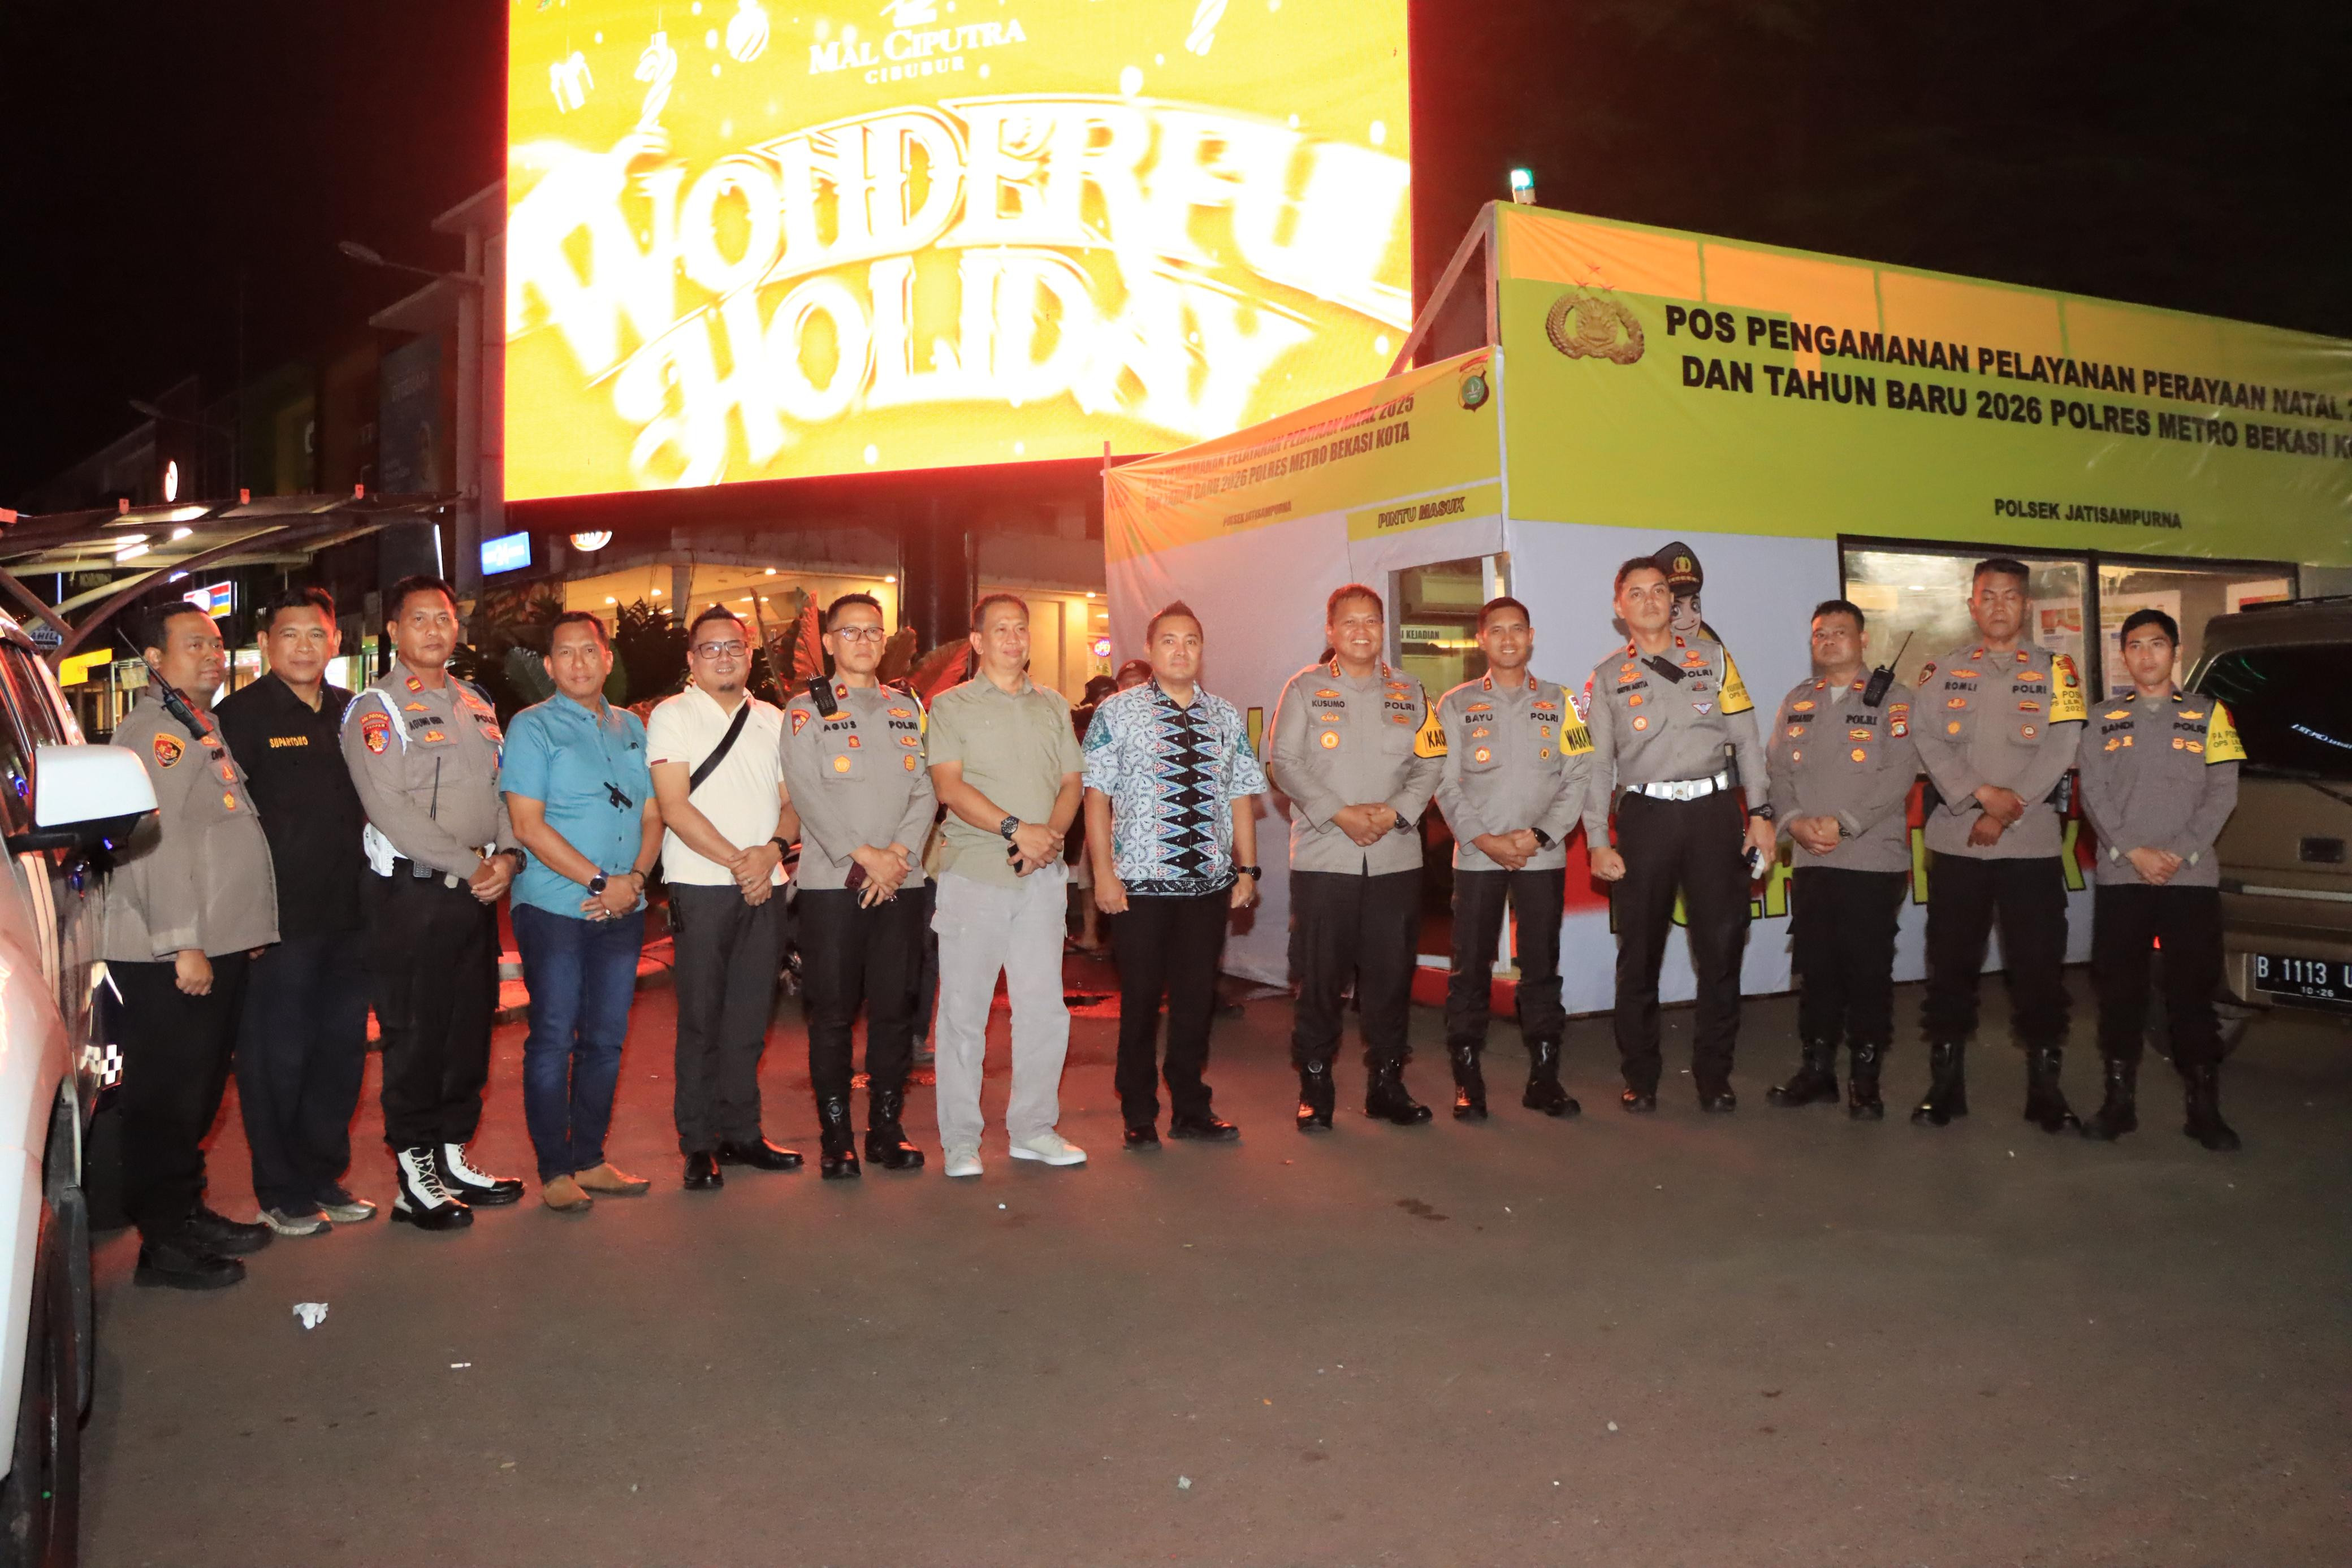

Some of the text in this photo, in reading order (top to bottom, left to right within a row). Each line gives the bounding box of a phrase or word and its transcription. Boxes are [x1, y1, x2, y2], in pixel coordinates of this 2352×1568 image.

[808, 19, 1027, 75] MAL CIPUTRA
[864, 56, 965, 84] CIBUBUR
[1665, 305, 1735, 343] POS
[1746, 316, 1971, 373] PENGAMANAN
[1978, 347, 2135, 393] PELAYANAN
[2143, 369, 2266, 412] PERAYAAN
[2273, 388, 2344, 421] NATAL
[1378, 392, 1414, 421] 2025
[1682, 355, 1753, 393] DAN
[1763, 365, 1876, 407] TAHUN
[1887, 380, 1968, 415] BARU
[1977, 391, 2042, 424] 2026
[2051, 399, 2151, 436] POLRES
[2159, 413, 2238, 447] METRO
[2245, 424, 2327, 458] BEKASI
[1221, 469, 1247, 492] 2026
[1248, 457, 1287, 485] POLRES
[1289, 445, 1328, 473] METRO
[1329, 431, 1373, 462] BEKASI
[1376, 421, 1410, 448] KOTA
[1378, 496, 1465, 529] PINTU MASUK
[1995, 499, 2182, 530] POLSEK JATISAMPURNA
[1406, 630, 1439, 639] KEJADIAN
[1945, 682, 1977, 692] ROMLI
[2012, 685, 2047, 694] POLRI
[1312, 699, 1345, 708] KUSUMO
[1385, 701, 1415, 711] POLRI
[1465, 714, 1493, 723] BAYU
[1530, 713, 1558, 722] POLRI
[1845, 714, 1878, 725] POLRI
[824, 721, 857, 732] AGUS
[888, 720, 918, 731] POLRI
[2173, 722, 2207, 734] POLRI
[269, 736, 308, 748] SUPARTONO
[2213, 739, 2228, 748] OPS
[2258, 956, 2268, 977] B
[2282, 959, 2327, 984] 1113
